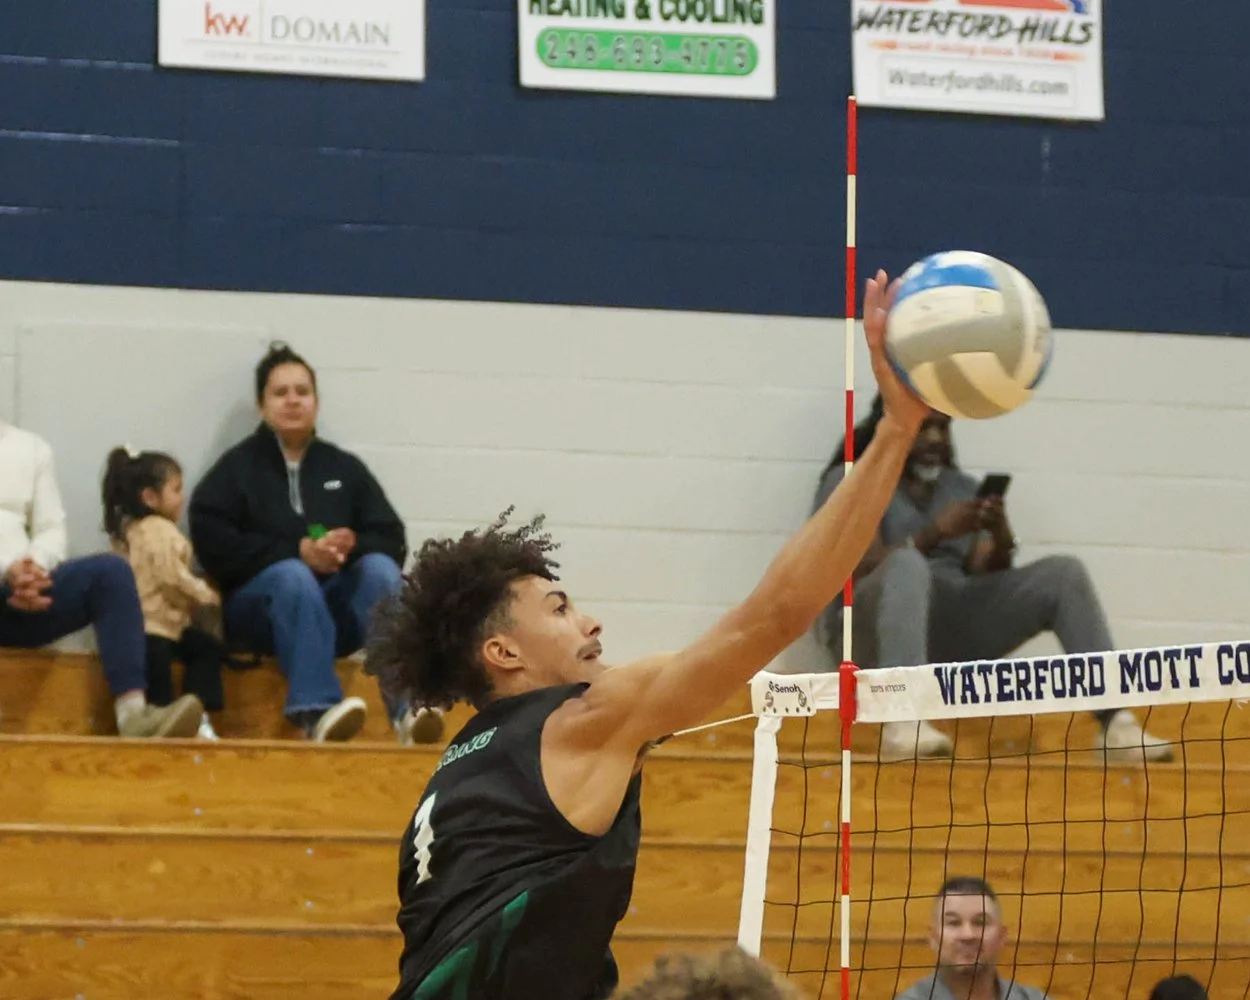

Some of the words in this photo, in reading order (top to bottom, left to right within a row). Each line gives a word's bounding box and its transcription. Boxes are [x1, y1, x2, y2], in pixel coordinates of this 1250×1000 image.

[659, 0, 764, 24] COOLING
[270, 14, 391, 45] DOMAIN
[774, 683, 800, 694] Senoh
[934, 655, 1106, 706] WATERFORD
[1119, 648, 1203, 694] MOTT
[414, 792, 436, 885] 1
